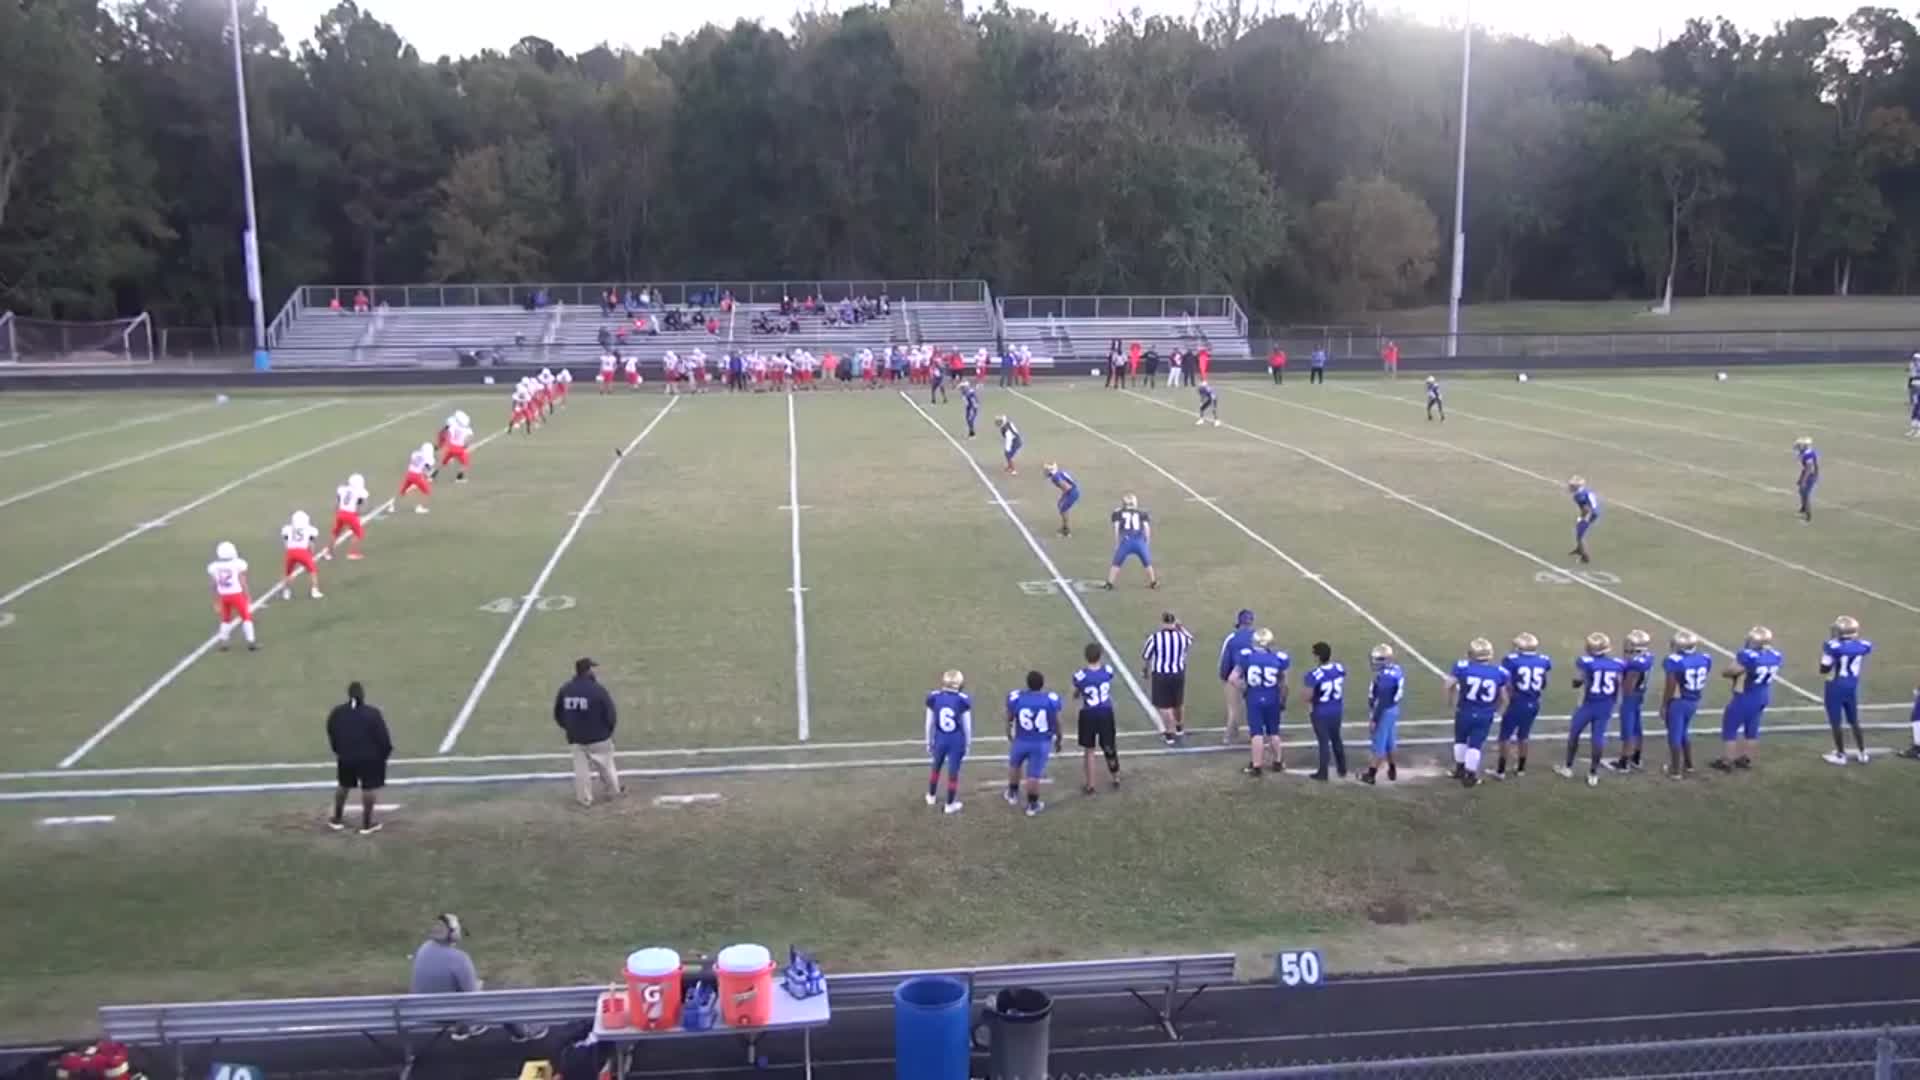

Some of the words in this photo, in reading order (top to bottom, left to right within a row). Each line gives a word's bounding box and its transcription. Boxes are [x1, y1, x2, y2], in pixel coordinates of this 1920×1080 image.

[1247, 665, 1279, 687] 65
[1517, 666, 1545, 691] 35
[1840, 655, 1862, 677] 14
[1319, 676, 1344, 702] 75
[1466, 676, 1497, 702] 73
[1591, 671, 1617, 694] 15
[939, 707, 956, 732] 6
[1019, 708, 1048, 733] 64
[1281, 951, 1319, 987] 50
[644, 985, 661, 1003] G
